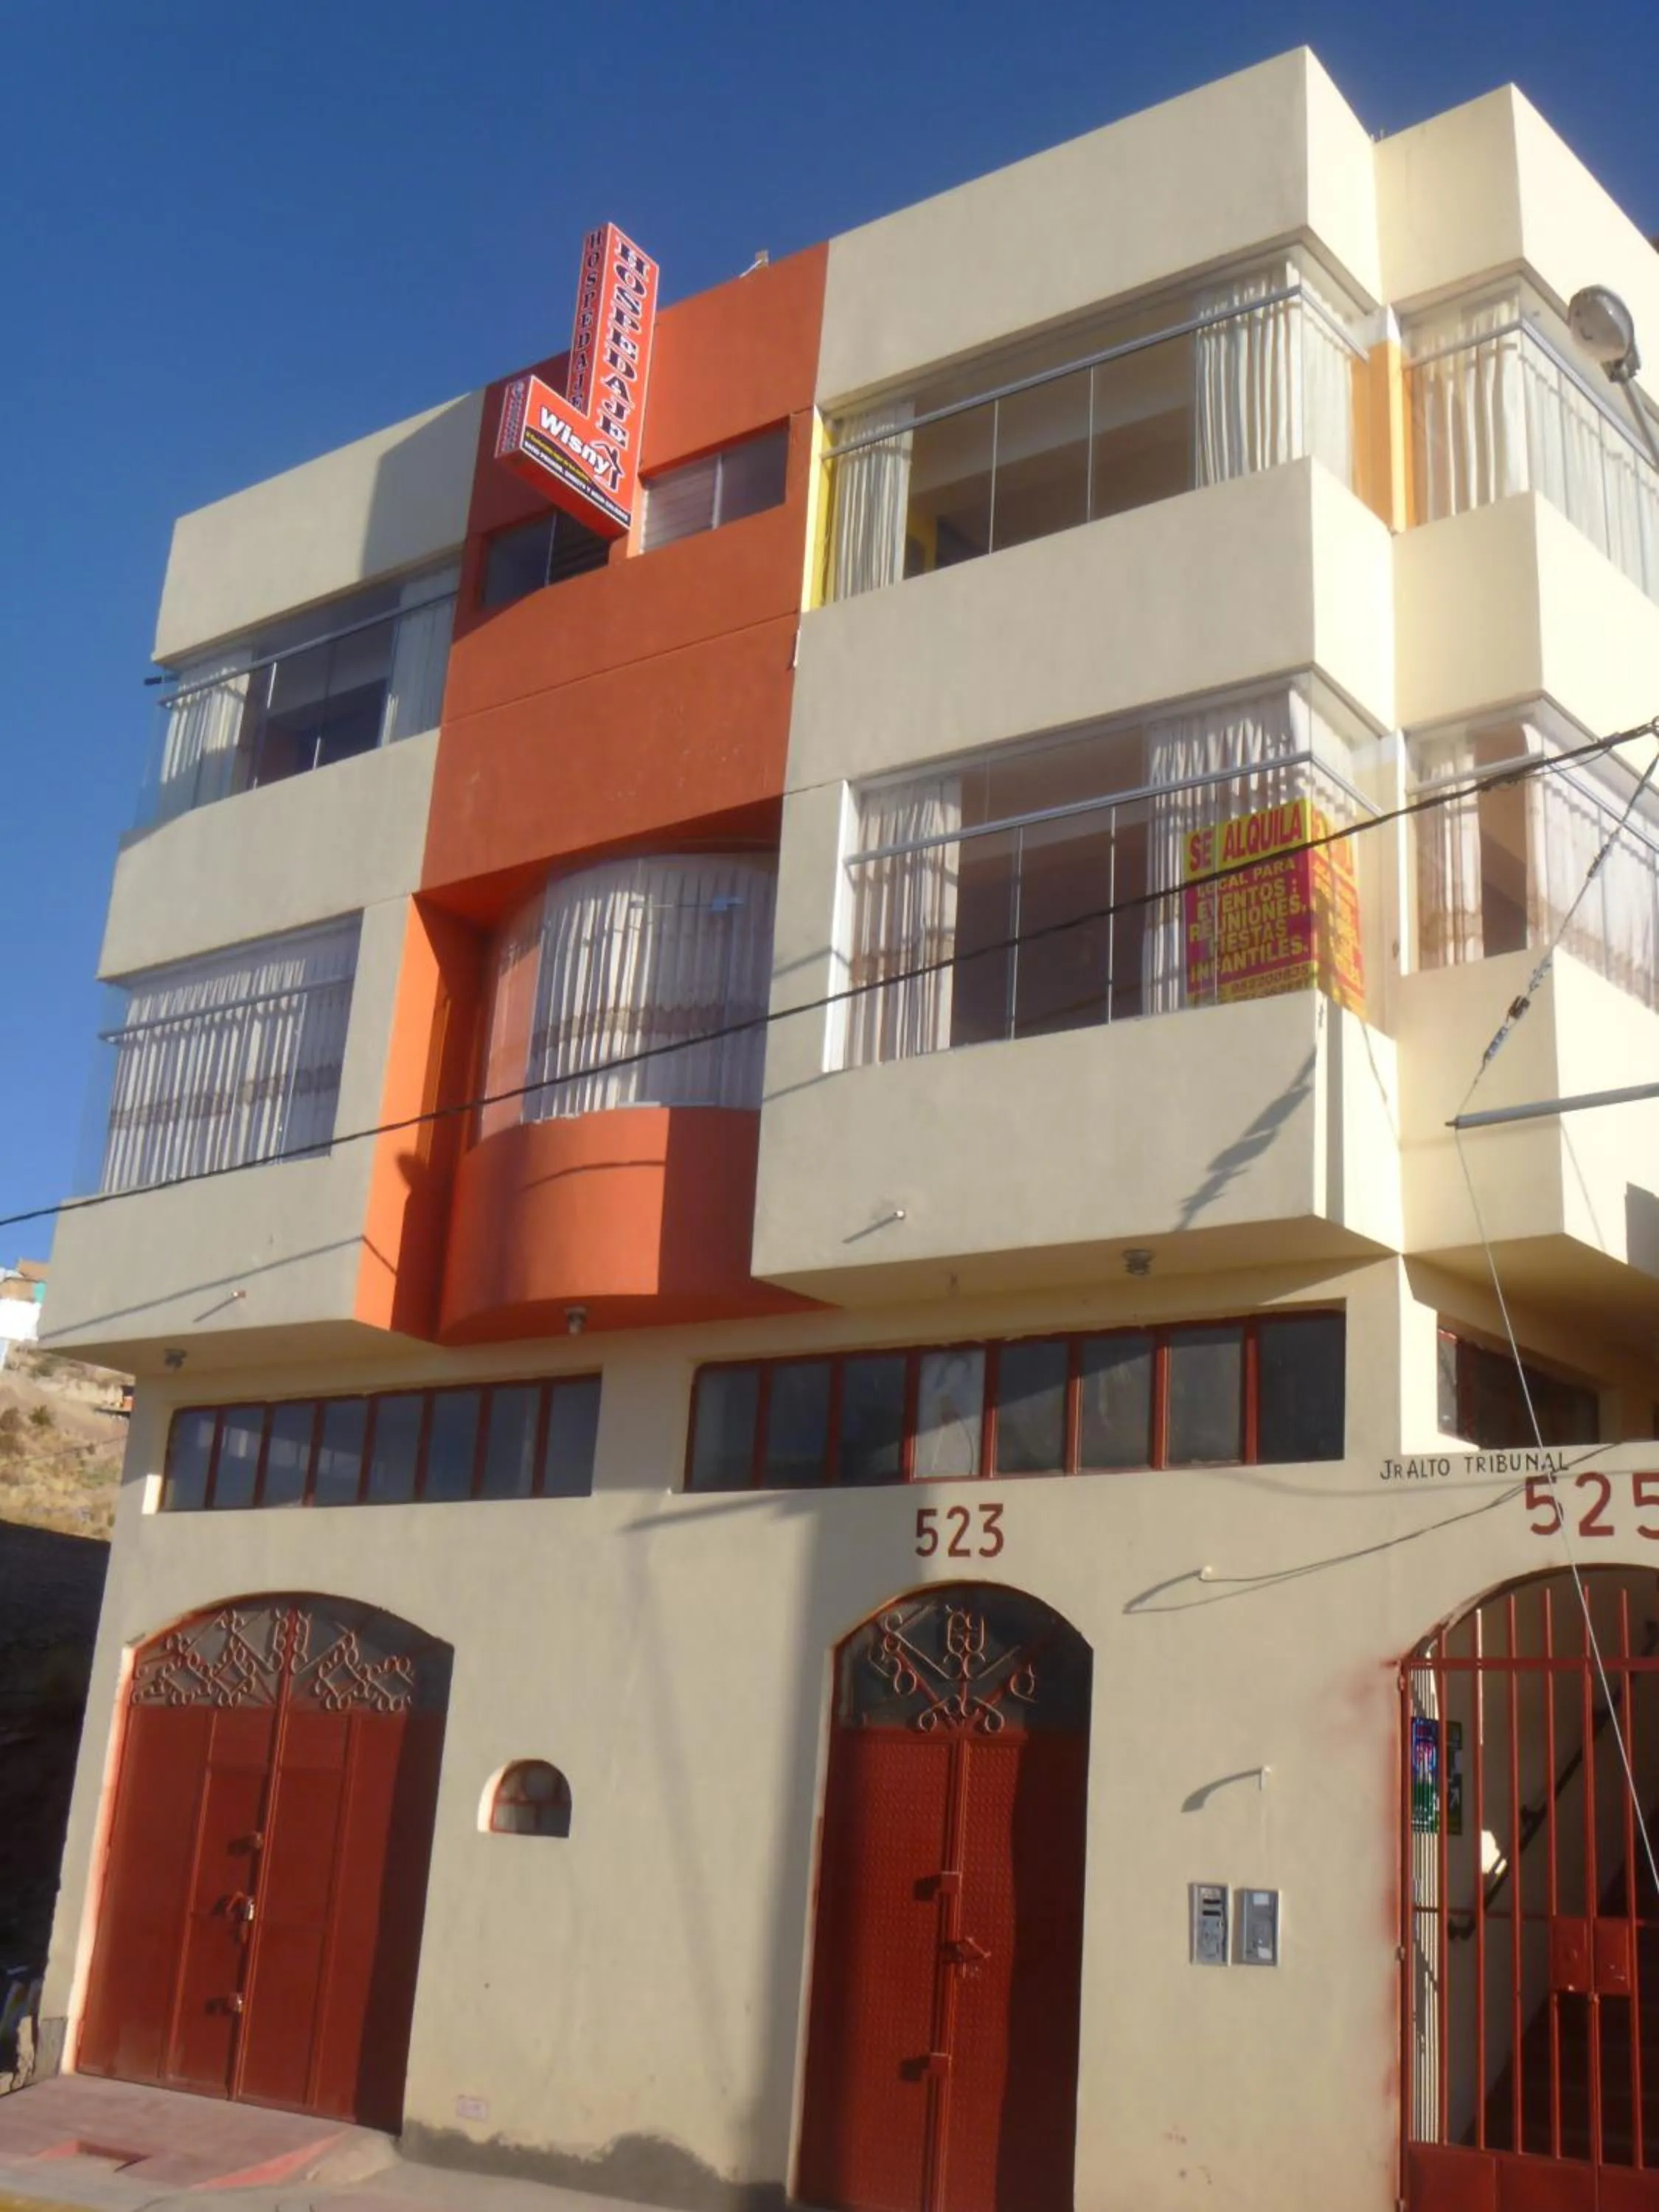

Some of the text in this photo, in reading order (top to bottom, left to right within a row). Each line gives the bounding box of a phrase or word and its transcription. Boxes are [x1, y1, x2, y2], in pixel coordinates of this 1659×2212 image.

[571, 229, 602, 410] HOSPEDAJE
[596, 234, 650, 451] HOSPEDAJE
[1189, 803, 1303, 872] SE ALQUILA
[1253, 858, 1295, 880] PARA
[1406, 1458, 1451, 1479] ALTO
[1464, 1451, 1569, 1474] TRIBUNAL
[914, 1503, 1004, 1558] 523
[1524, 1470, 1659, 1540] 525
